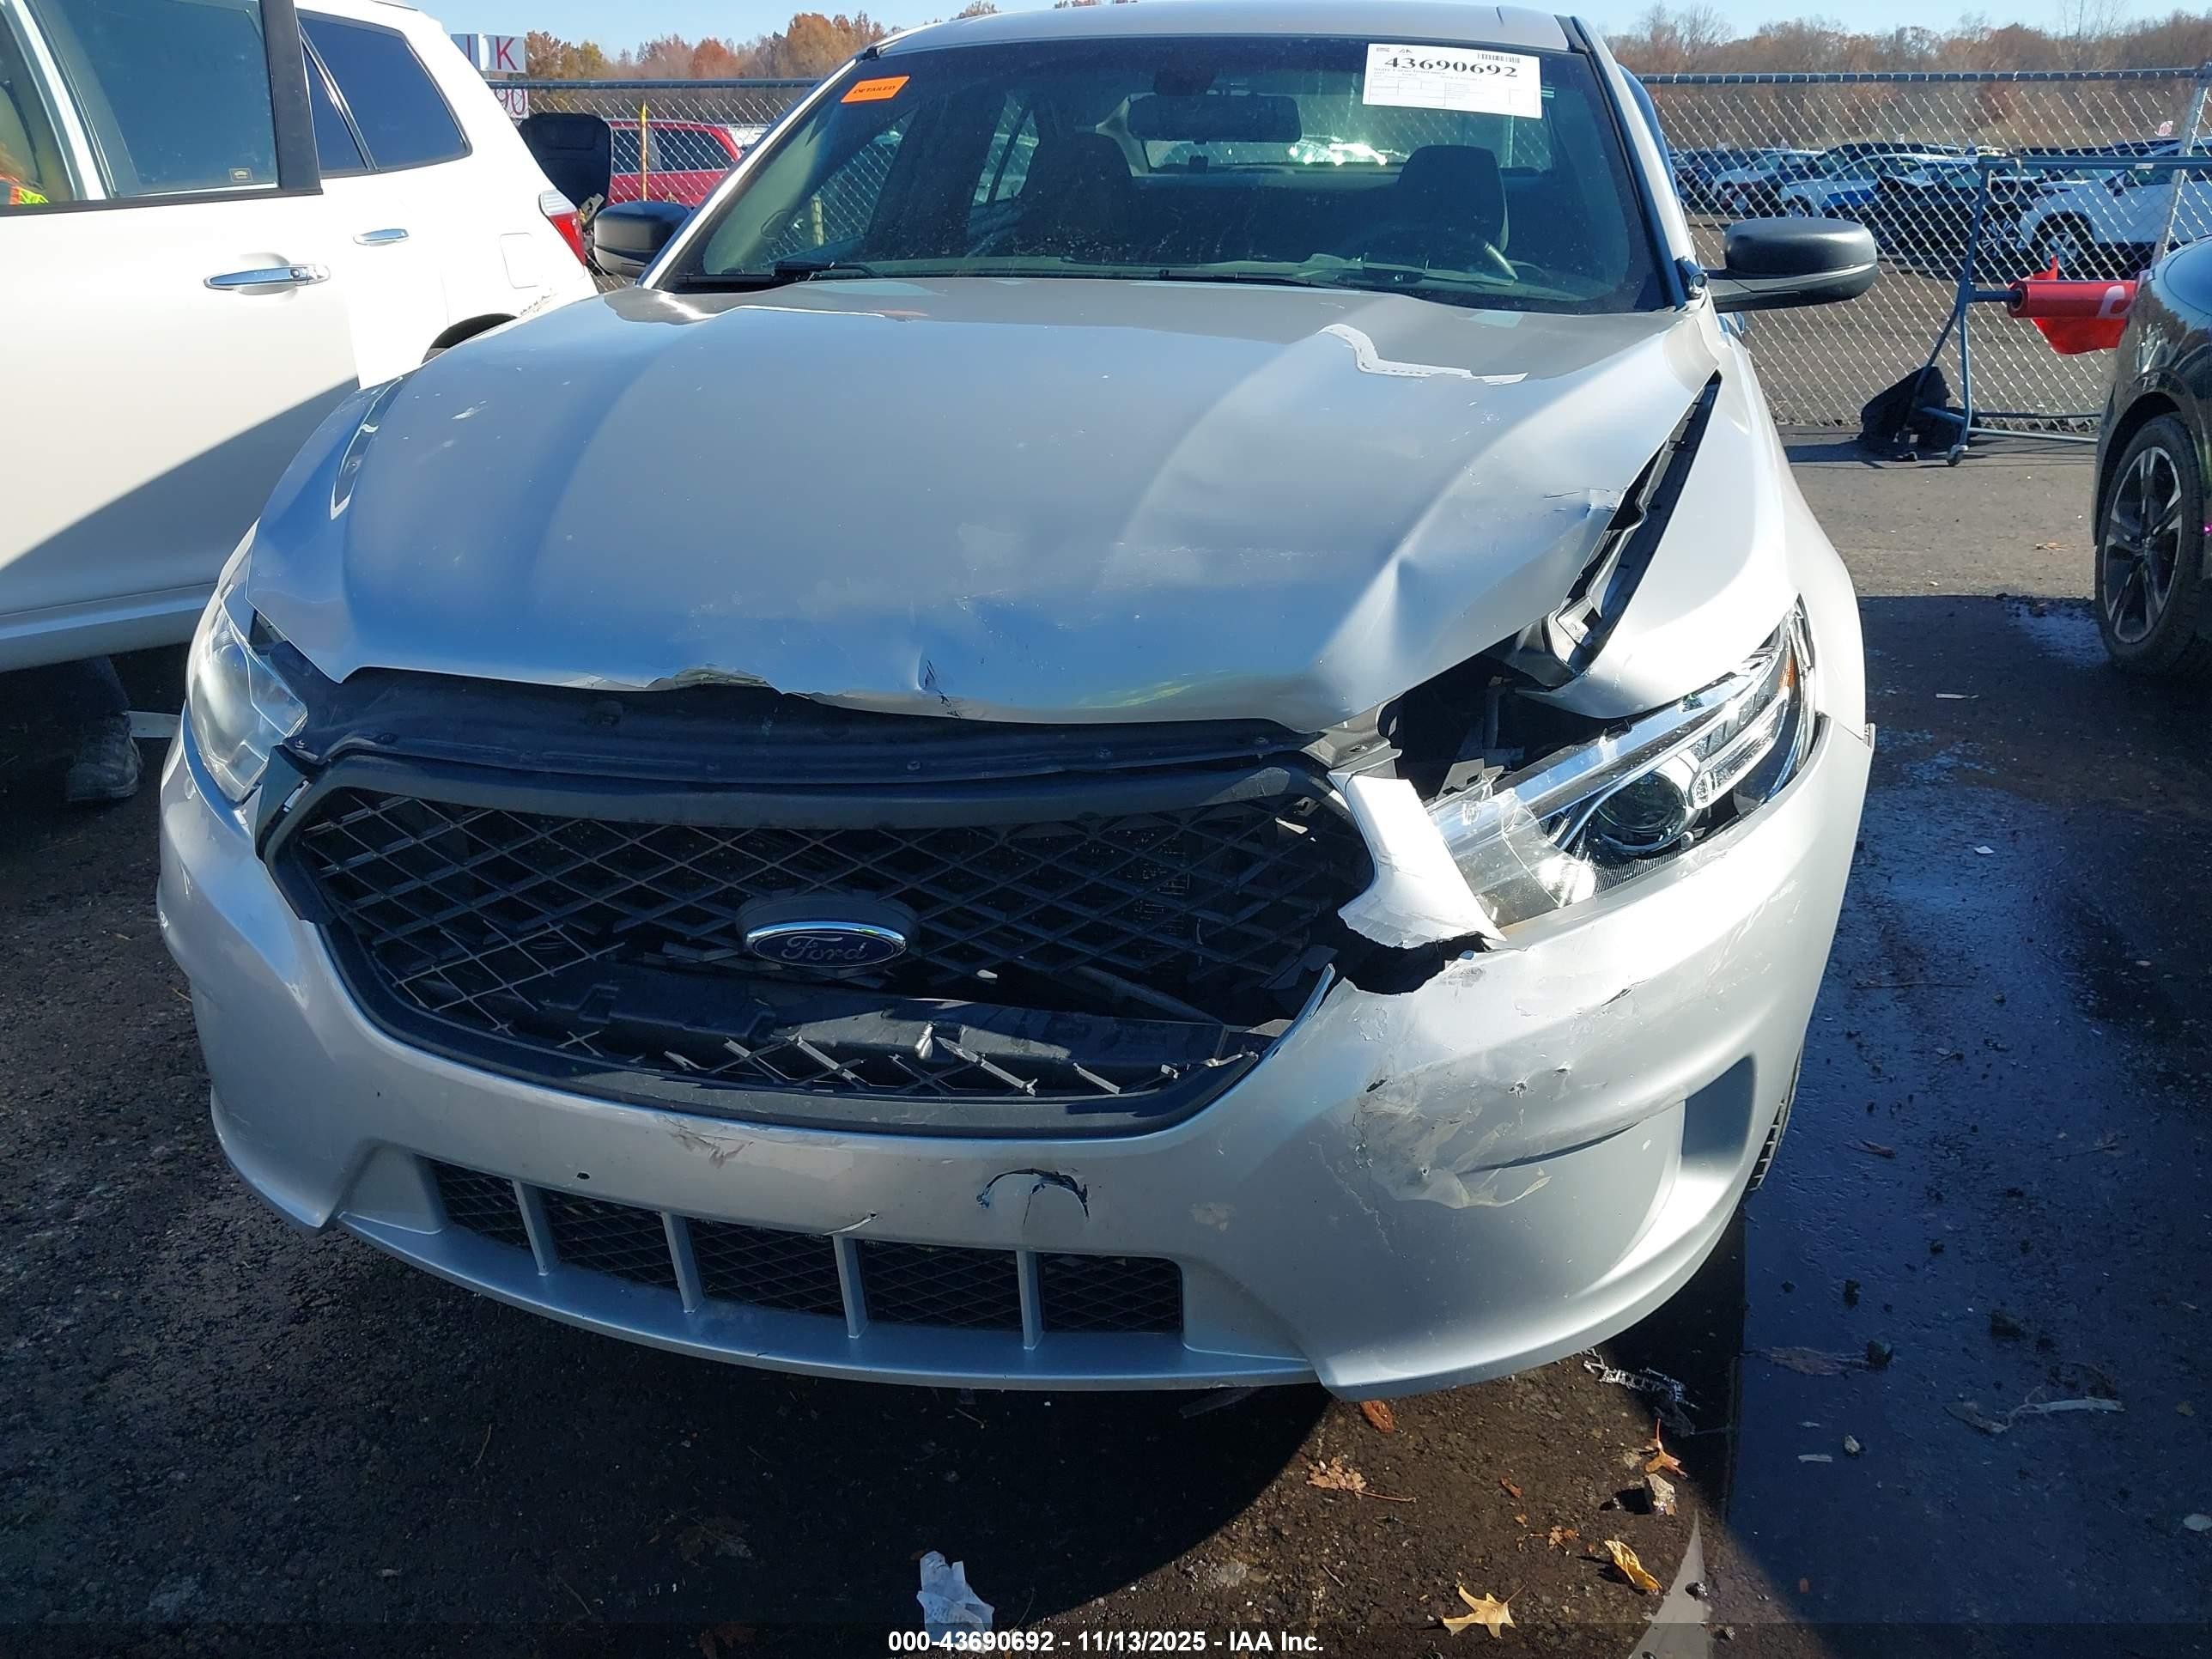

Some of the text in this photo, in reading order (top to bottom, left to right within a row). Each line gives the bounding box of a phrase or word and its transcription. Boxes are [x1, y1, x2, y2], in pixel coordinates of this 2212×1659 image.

[495, 37, 517, 70] K
[1384, 57, 1517, 77] 43690692
[782, 936, 868, 960] Ford
